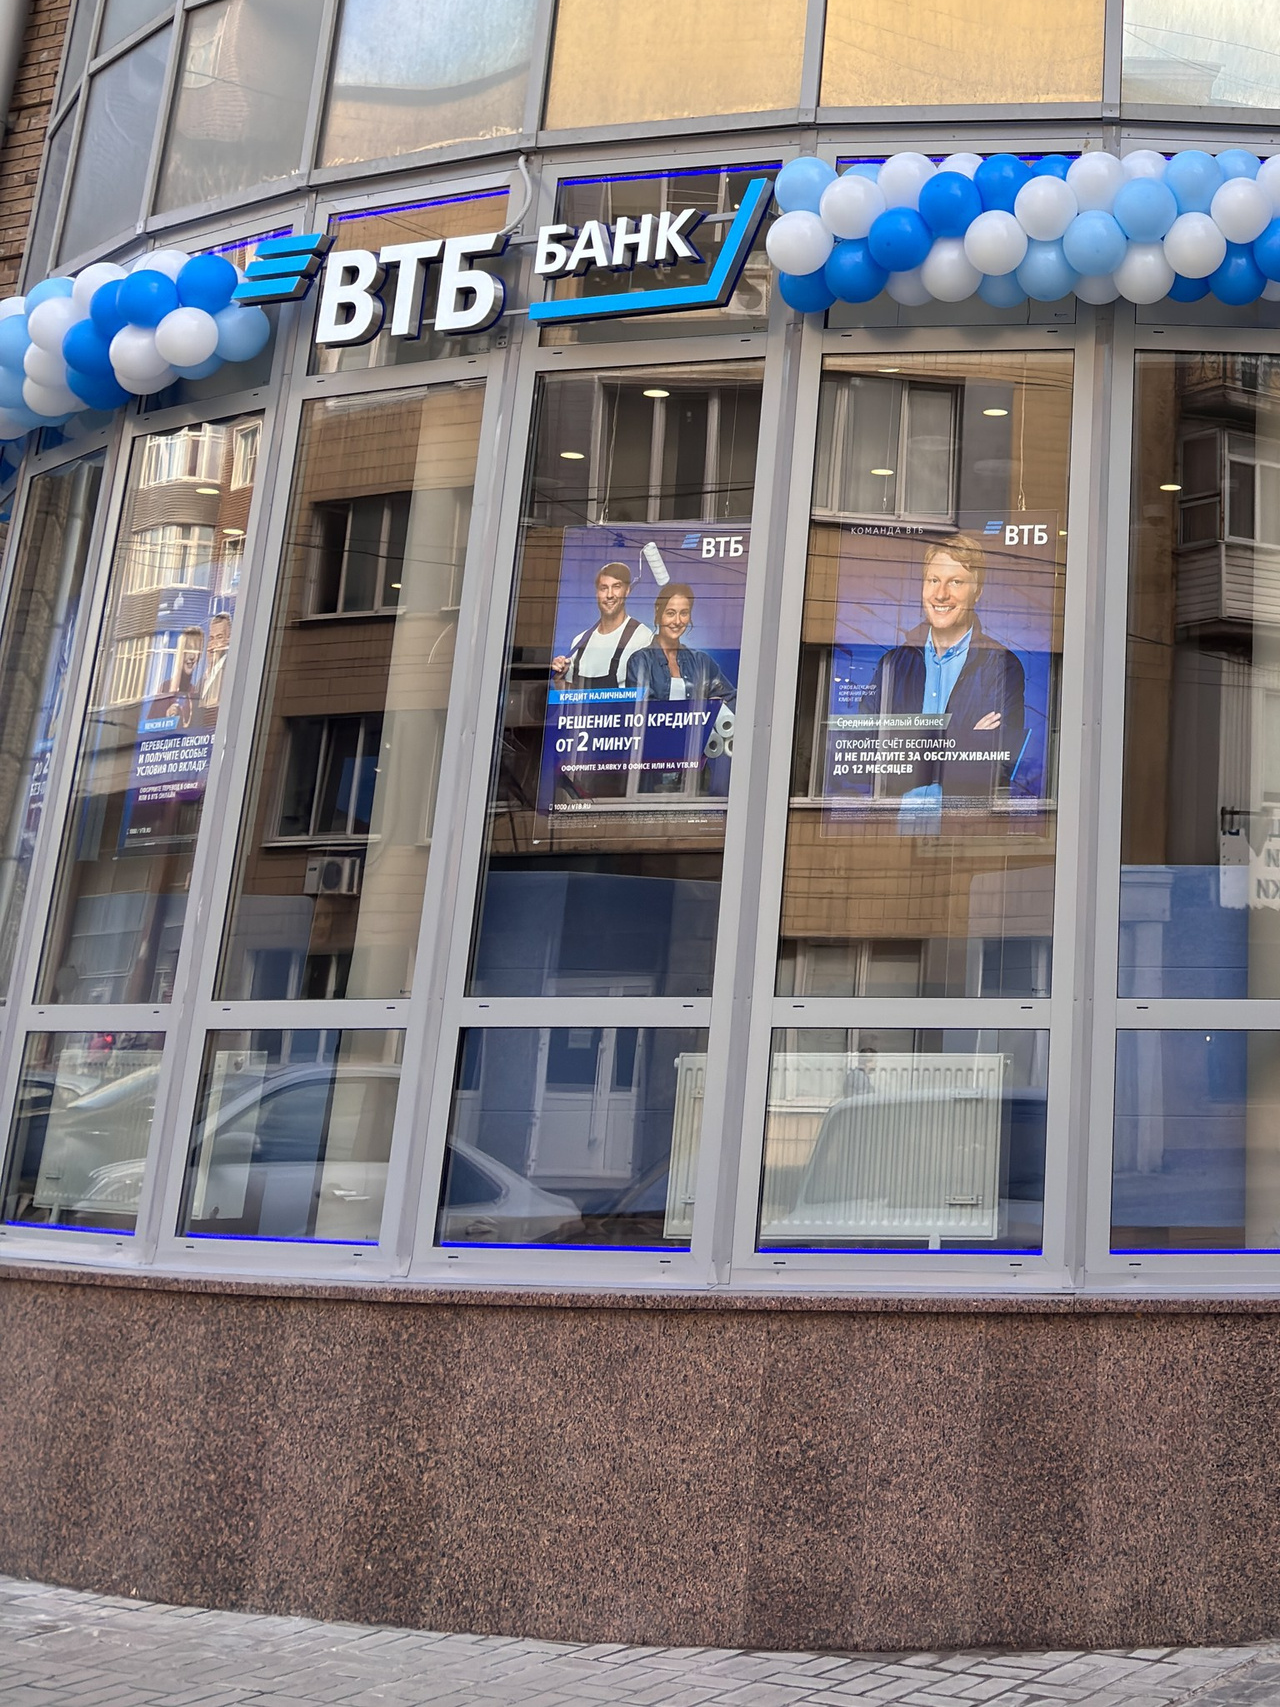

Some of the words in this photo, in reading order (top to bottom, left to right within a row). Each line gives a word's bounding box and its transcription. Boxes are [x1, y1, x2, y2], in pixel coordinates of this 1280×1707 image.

[315, 232, 506, 347] ВТБ
[534, 208, 704, 276] БАНК
[850, 526, 901, 536] КОМАНДА
[906, 526, 924, 535] ВТБ
[1004, 524, 1049, 546] ВТБ
[701, 536, 744, 559] ВТБ
[559, 691, 587, 701] КРЕДИТ
[588, 690, 637, 700] НАЛИЧНЫМИ
[558, 714, 621, 730] РЕШЕНИЕ
[624, 713, 644, 728] ПО
[647, 711, 711, 729] КРЕДИТУ
[836, 717, 874, 729] Средний
[875, 719, 882, 727] и
[883, 717, 912, 727] малый
[914, 716, 944, 727] бизнес
[140, 737, 181, 752] ПЕРЕВЕДИТЕ
[181, 734, 210, 747] ПЕНСИЮ
[555, 737, 575, 753] ОТ
[576, 731, 589, 752] 2
[592, 736, 642, 752] МИНУТ
[835, 737, 880, 750] ОТКРОЙТЕ
[882, 736, 903, 749] СЧЁТ
[906, 738, 956, 749] БЕСПЛАТНО
[138, 754, 144, 764] И
[144, 751, 179, 763] ПОЛУЧИТЕ
[180, 747, 208, 760] ОСОБЫЕ
[834, 752, 842, 761] И
[844, 752, 857, 761] НЕ
[859, 751, 906, 761] ПЛАТИТЕ
[907, 751, 921, 761] ЗА
[924, 751, 1011, 761] ОБСЛУЖИВАНИЕ
[136, 763, 167, 776] УСЛОВИЯ
[167, 762, 178, 773] ПО
[178, 760, 208, 772] ВКЛАДУ
[561, 763, 596, 772] ОФОРМИТЕ
[597, 762, 622, 771] ЗАЯВКУ
[622, 762, 627, 770] В
[628, 762, 650, 770] ОФИСЕ
[651, 762, 665, 770] ИЛИ
[676, 761, 699, 769] VTB.RU
[833, 764, 849, 776] ДО
[852, 764, 863, 774] 12
[865, 764, 914, 775] МЕСЯЦЕВ
